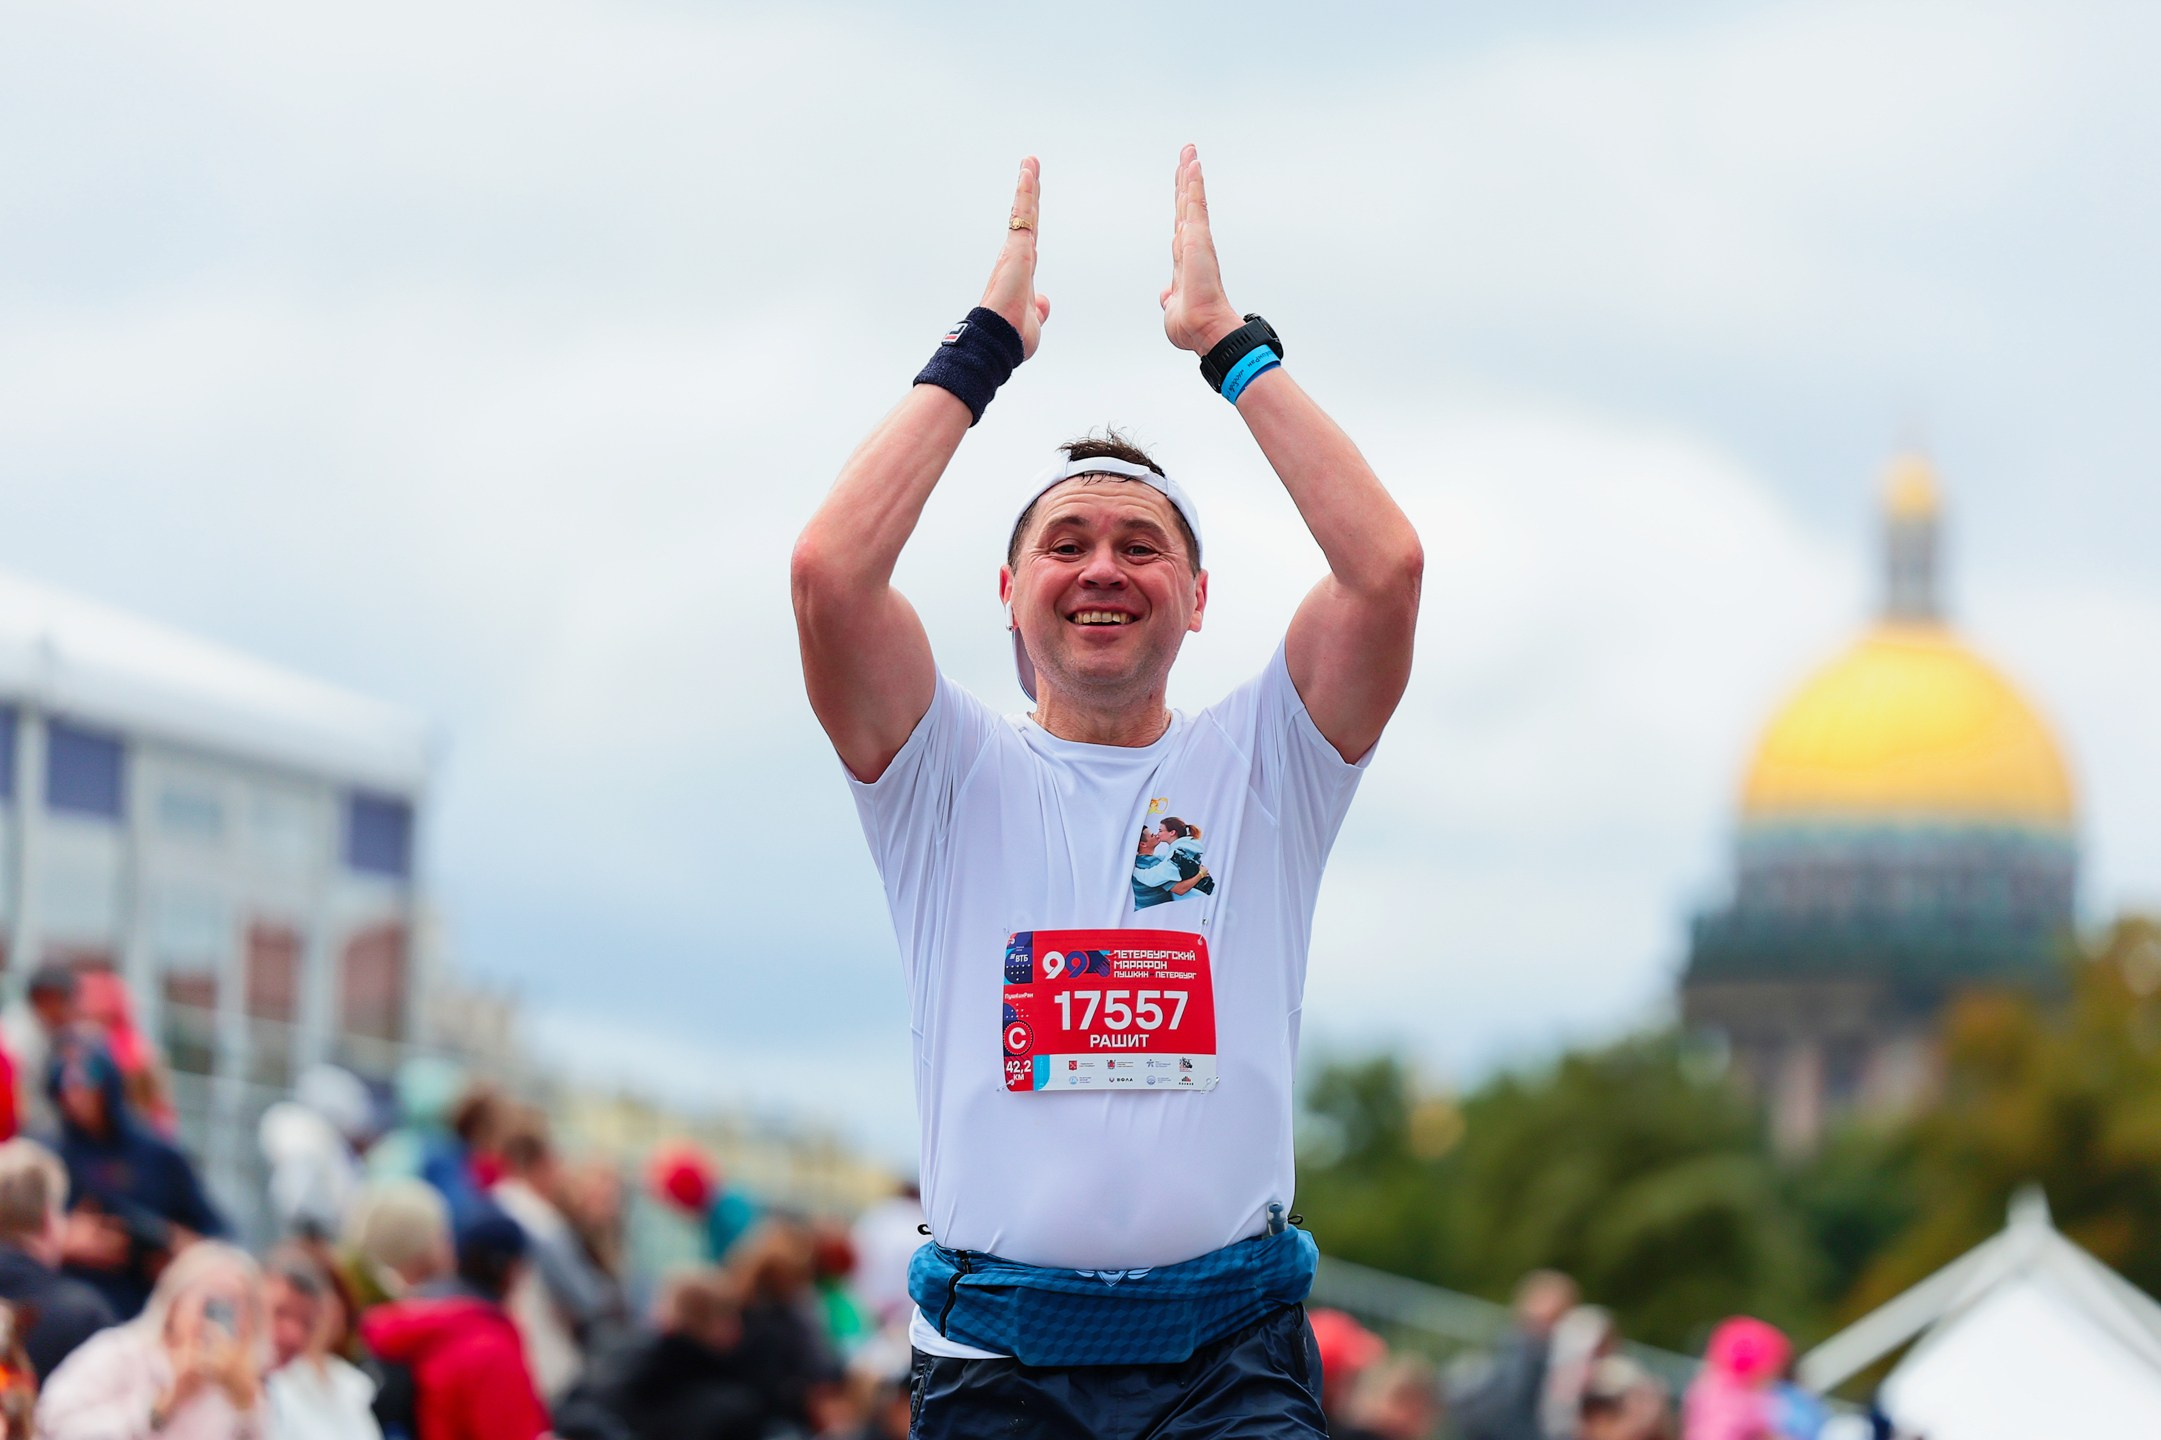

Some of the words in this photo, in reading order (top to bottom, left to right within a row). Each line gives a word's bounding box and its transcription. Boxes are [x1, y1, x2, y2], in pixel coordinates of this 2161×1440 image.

[1015, 954, 1029, 962] ВТБ
[1113, 960, 1168, 970] МАРАФОН
[1113, 970, 1149, 978] ПУШКИН
[1155, 971, 1197, 980] ПЕТЕРБУРГ
[1054, 990, 1188, 1030] 17557
[1090, 1034, 1149, 1048] РАШИТ
[1006, 1059, 1032, 1073] 42,2
